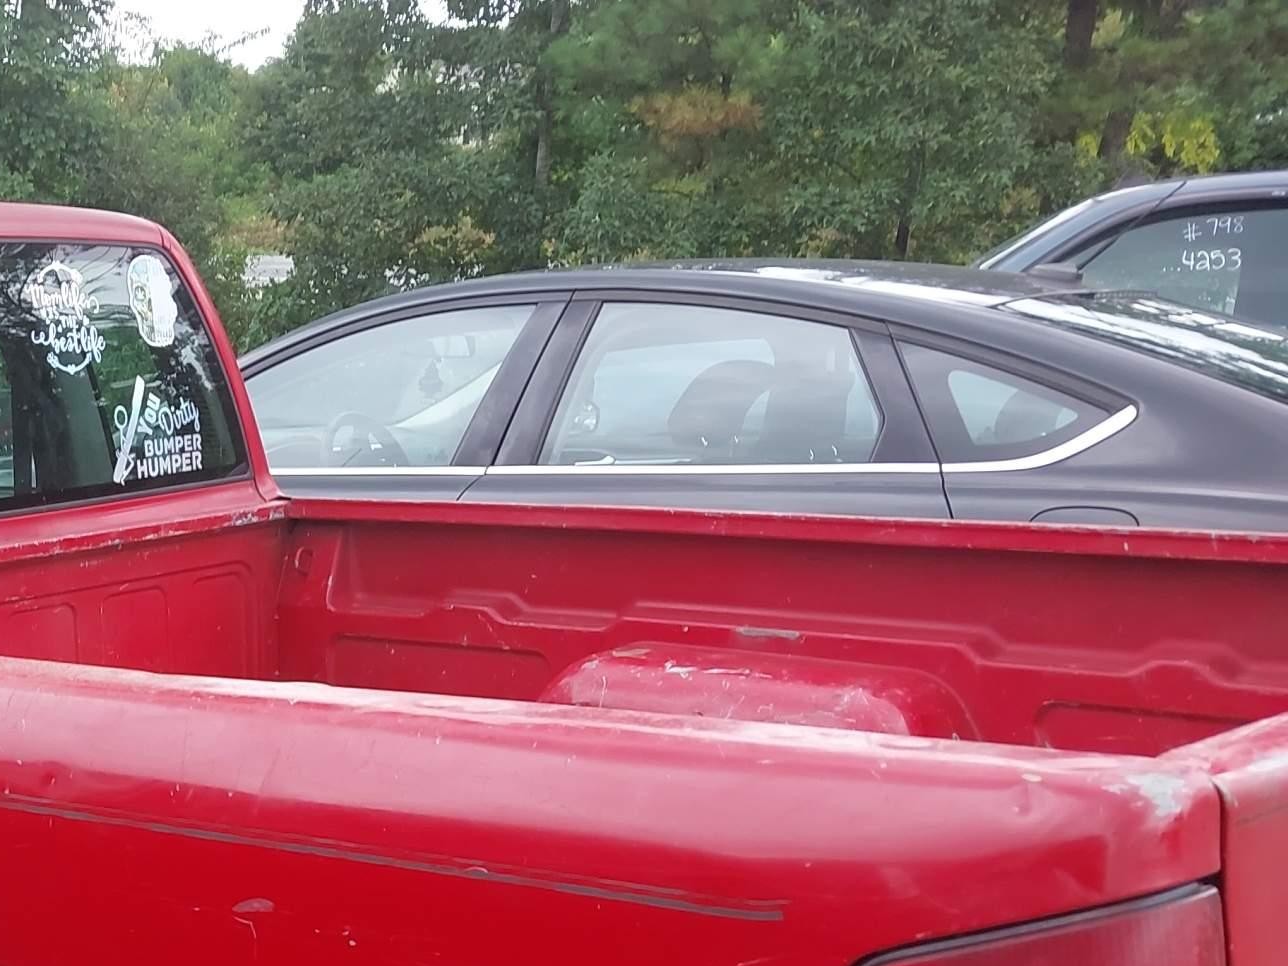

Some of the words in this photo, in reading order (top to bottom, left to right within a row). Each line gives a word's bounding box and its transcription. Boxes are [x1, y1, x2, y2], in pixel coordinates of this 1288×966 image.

[1206, 216, 1244, 236] 798
[80, 325, 105, 363] life
[154, 396, 201, 436] Dirty
[144, 433, 202, 458] BUMPER
[136, 451, 203, 480] HUMPER
